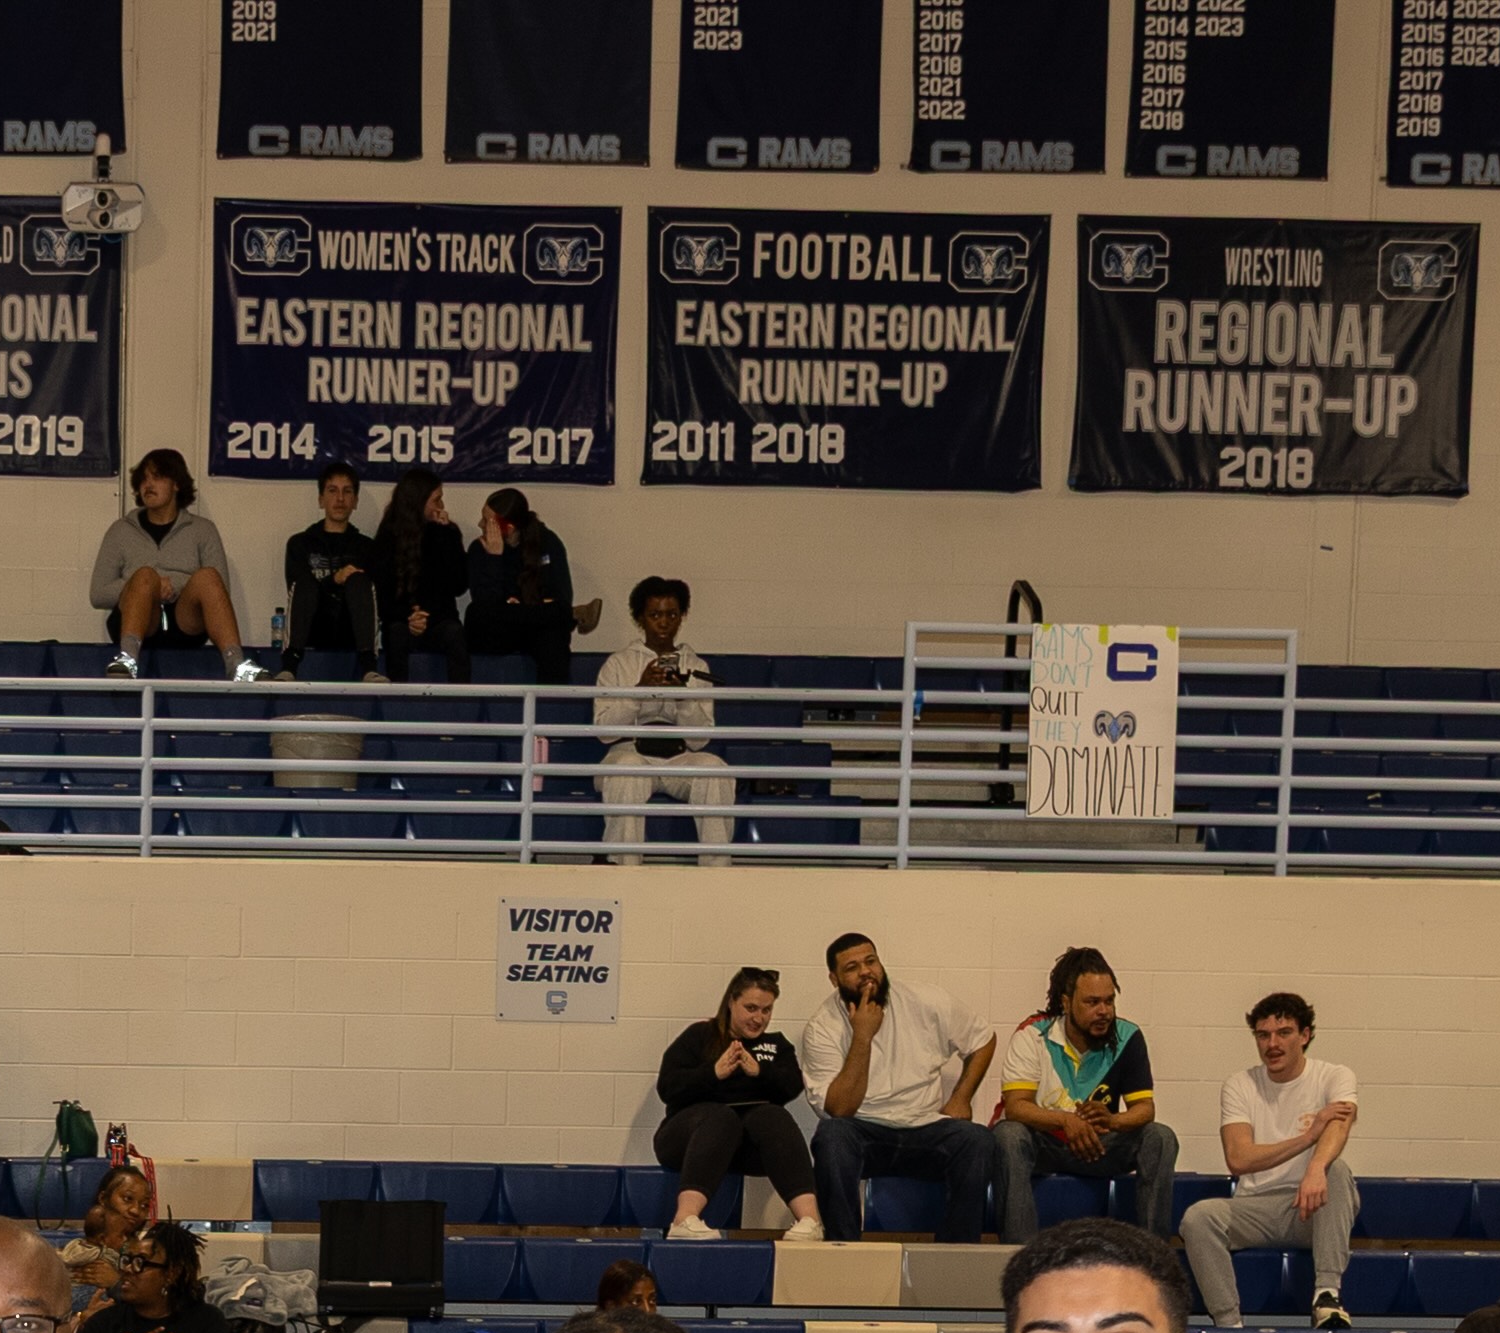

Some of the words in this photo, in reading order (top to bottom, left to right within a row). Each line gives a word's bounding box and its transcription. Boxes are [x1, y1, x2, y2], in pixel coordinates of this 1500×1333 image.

[1140, 110, 1184, 130] 2018
[1397, 117, 1441, 138] 2019
[759, 138, 851, 169] RAMS
[318, 226, 434, 271] WOMEN'S
[438, 232, 515, 273] TRACK
[753, 233, 941, 284] FOOTBALL
[1225, 246, 1323, 288] WRESTLING
[236, 296, 402, 348] EASTERN
[415, 301, 591, 353] REGIONAL
[676, 302, 837, 348] EASTERN
[842, 305, 1016, 353] REGIONAL
[1154, 301, 1395, 369] REGIONAL
[307, 356, 519, 405] RUNNER-UP
[738, 360, 948, 408] RUNNER-UP
[1123, 370, 1418, 437] RUNNER-UP
[227, 423, 316, 460] 2014
[368, 424, 454, 462] 2015
[508, 427, 594, 466] 2017
[652, 421, 735, 462] 2011
[752, 423, 845, 463] 2018
[1219, 446, 1314, 489] 2018
[1033, 626, 1093, 661] RAMS
[1030, 687, 1083, 717] QUIT
[1034, 719, 1081, 745] THEY
[509, 908, 613, 934] VISITOR
[506, 963, 609, 984] SEATING
[526, 943, 593, 962] TEAM
